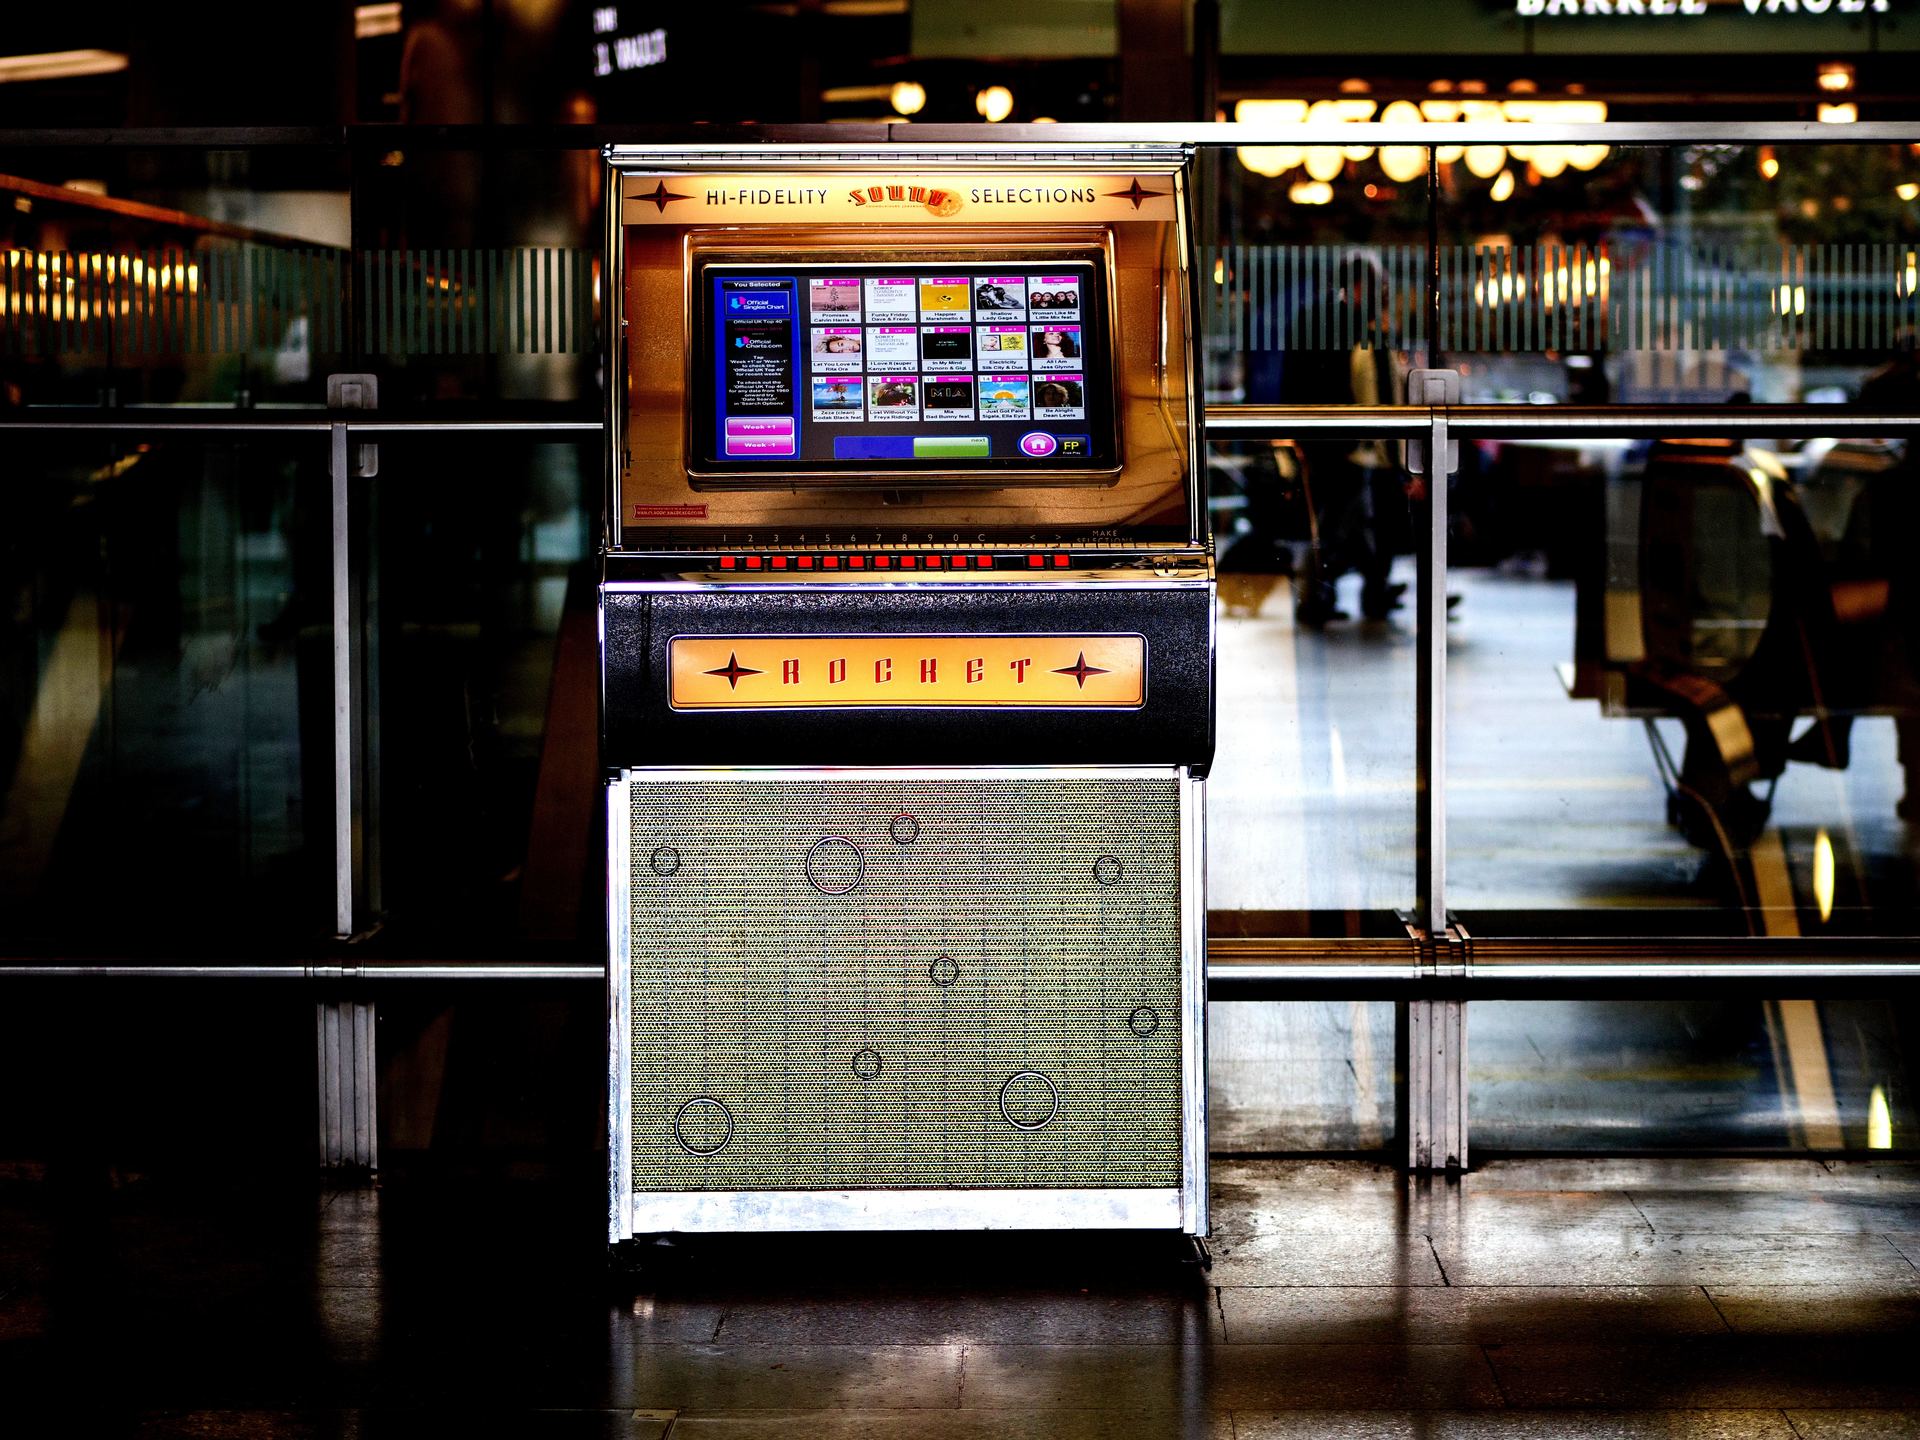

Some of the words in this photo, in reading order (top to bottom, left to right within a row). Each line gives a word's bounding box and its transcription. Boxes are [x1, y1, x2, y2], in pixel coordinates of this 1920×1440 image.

[706, 189, 827, 205] HI-FIDELITY
[849, 185, 948, 206] SOUND
[971, 188, 1095, 203] SELECTIONS
[931, 387, 966, 398] MIA
[1064, 441, 1079, 450] FP
[782, 658, 1031, 684] ROCKET
